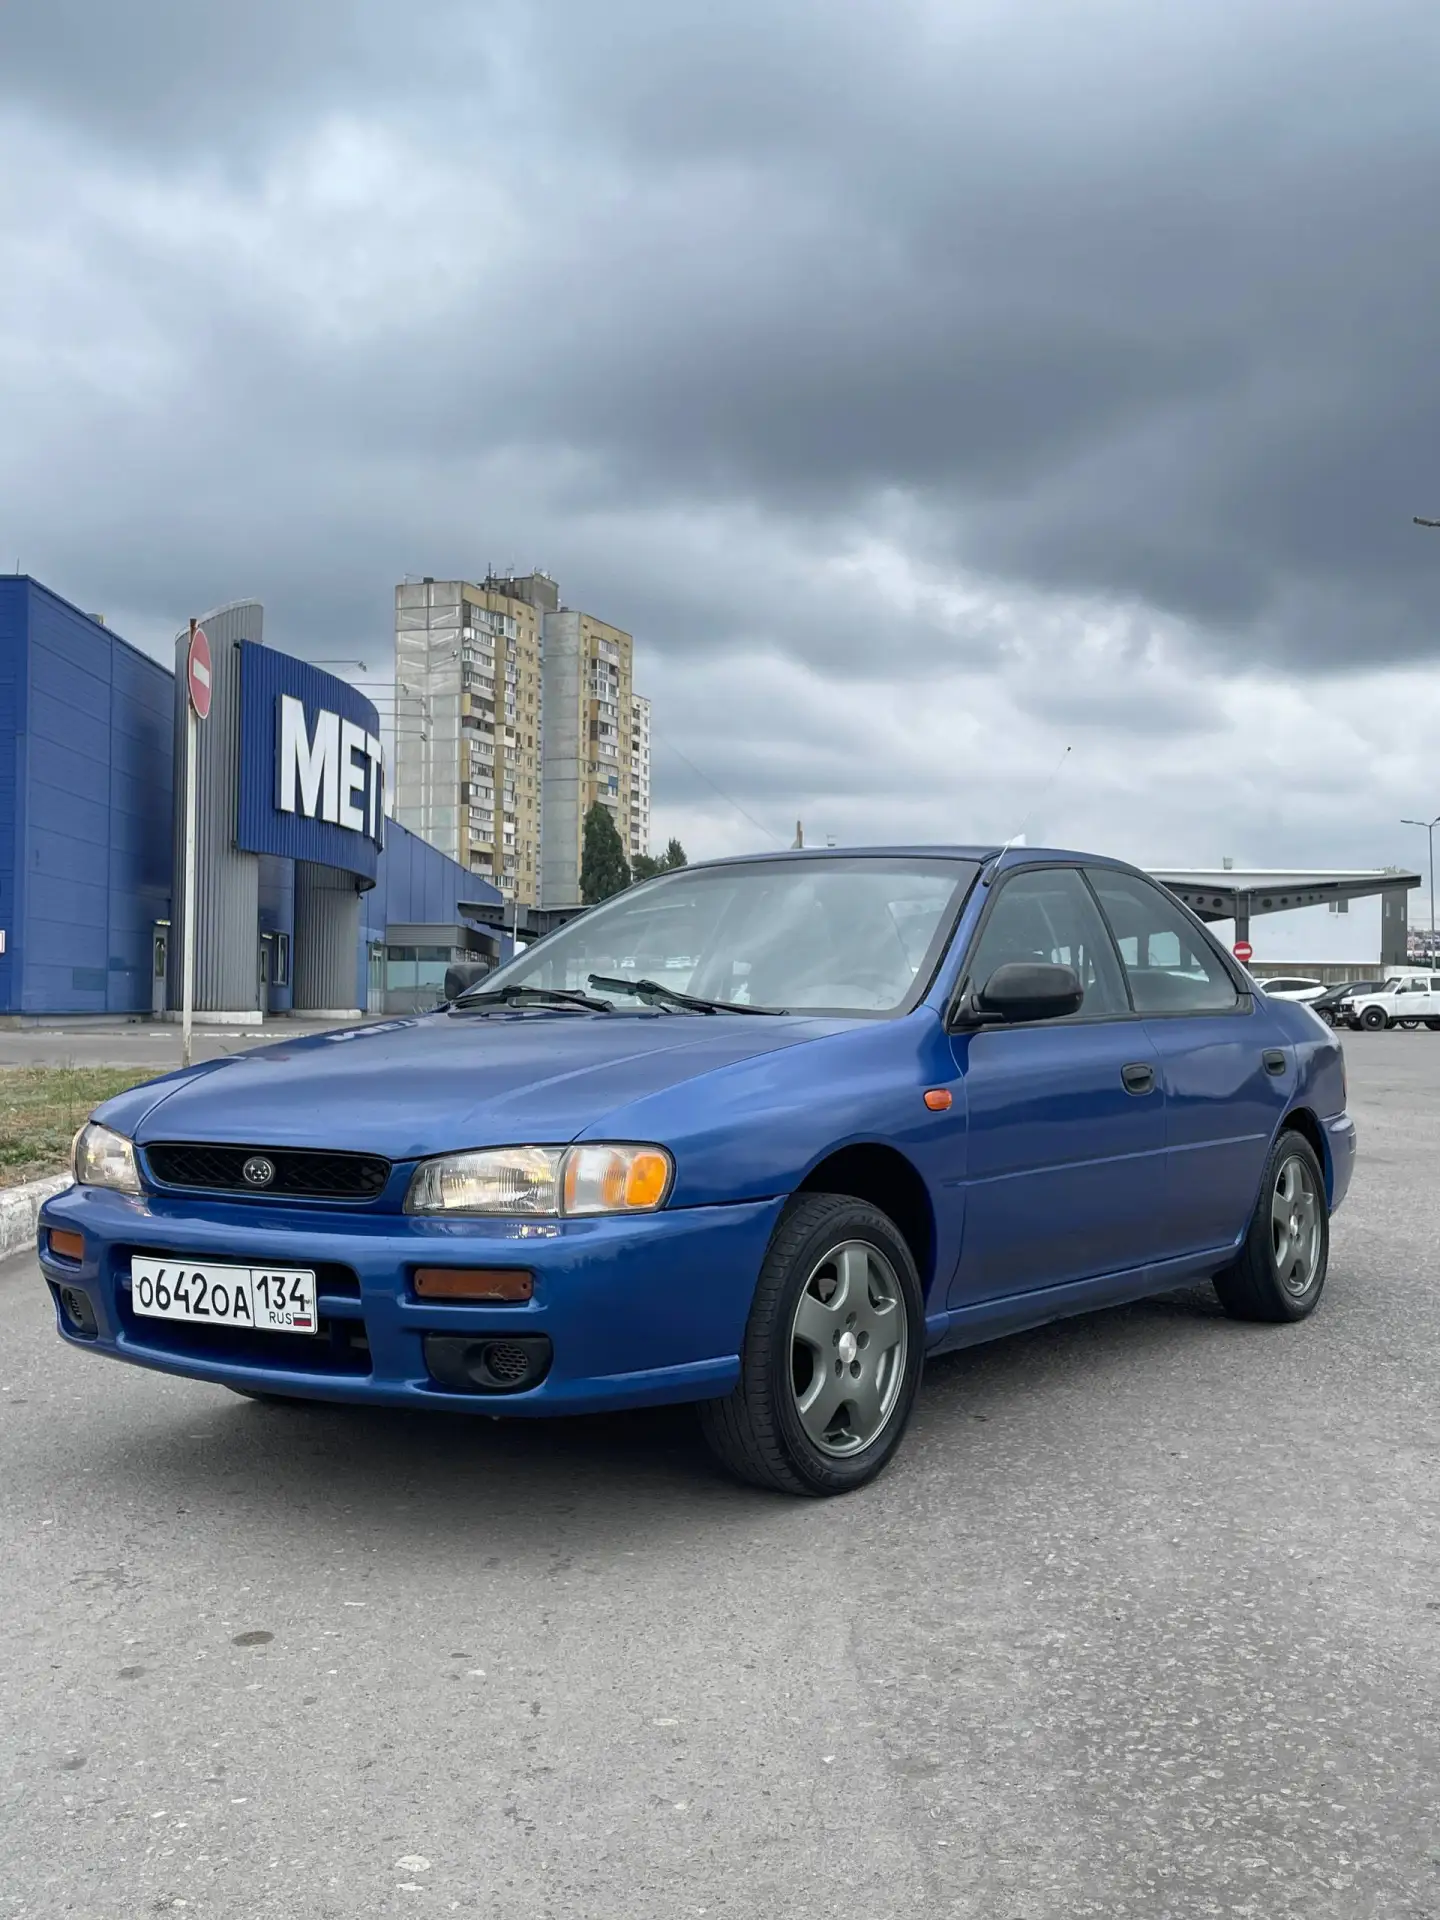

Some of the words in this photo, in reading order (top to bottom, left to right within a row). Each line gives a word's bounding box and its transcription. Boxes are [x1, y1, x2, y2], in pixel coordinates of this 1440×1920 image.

[280, 693, 384, 848] MET
[256, 1275, 306, 1312] 134
[269, 1311, 292, 1325] RUS
